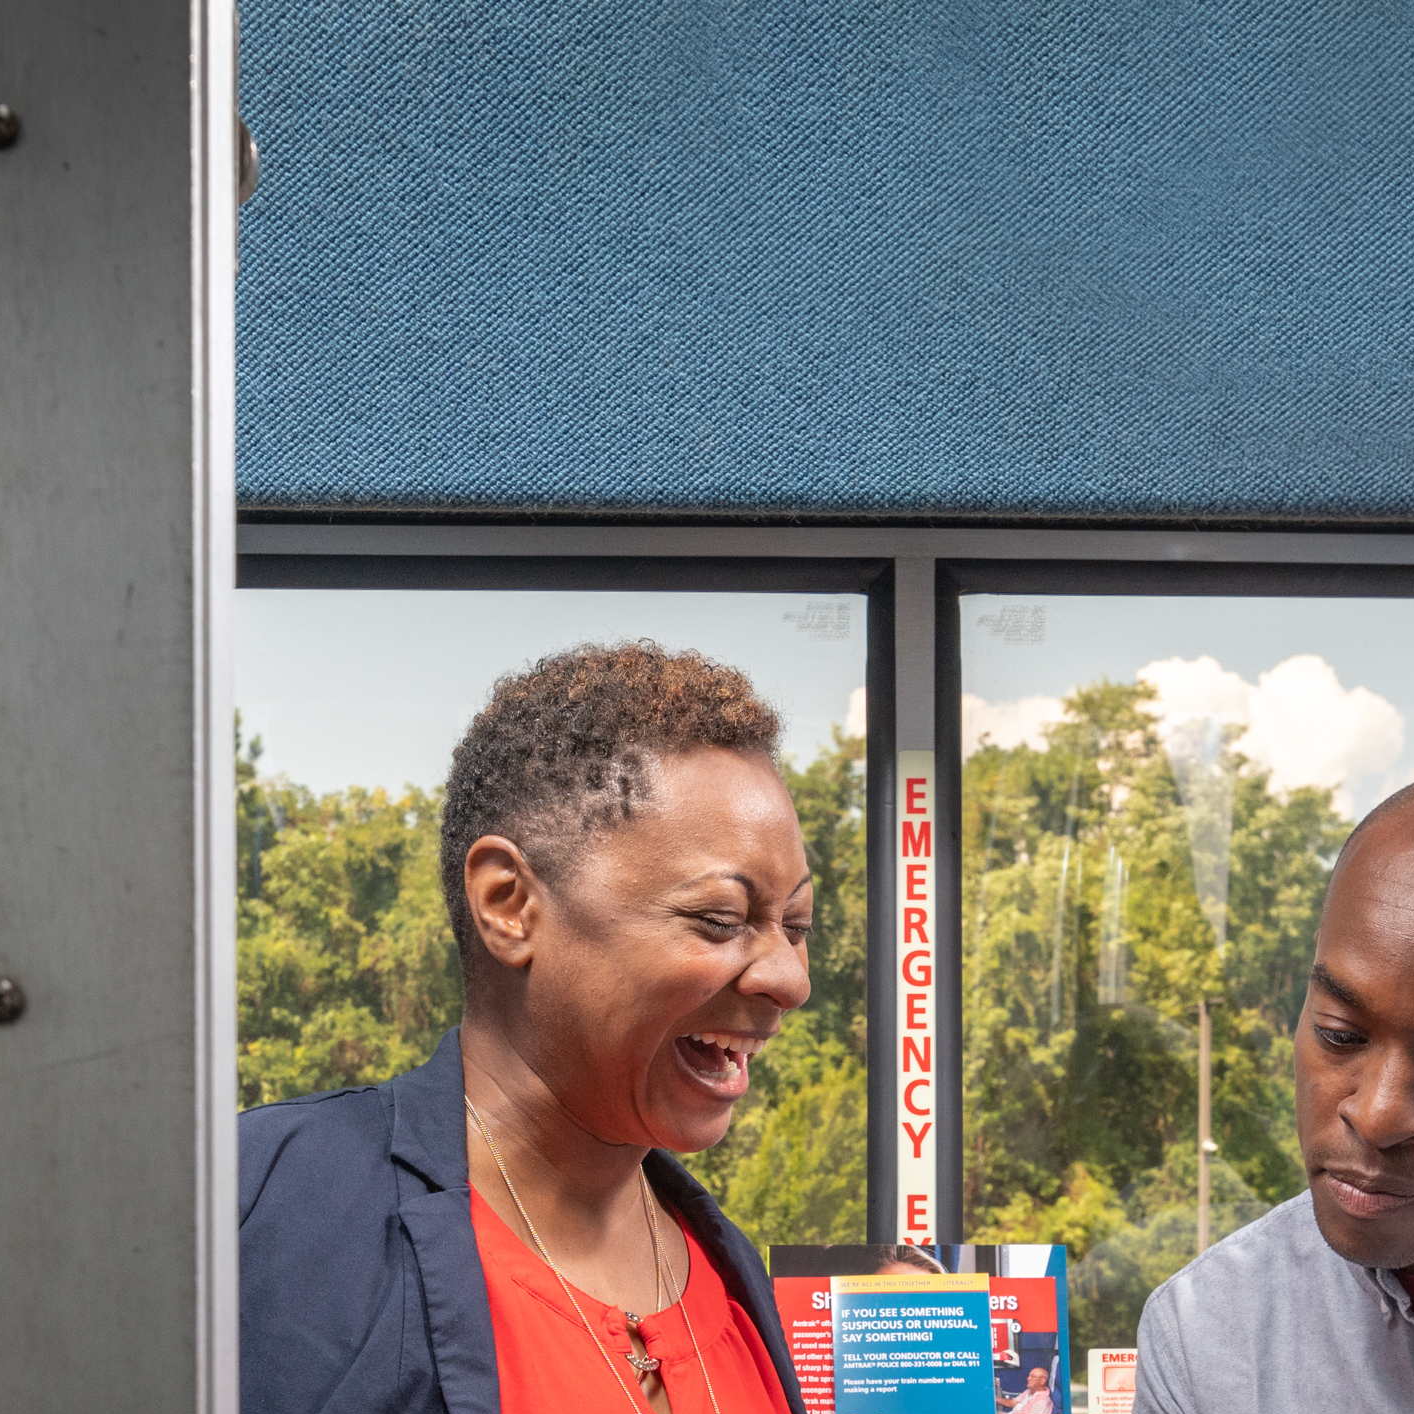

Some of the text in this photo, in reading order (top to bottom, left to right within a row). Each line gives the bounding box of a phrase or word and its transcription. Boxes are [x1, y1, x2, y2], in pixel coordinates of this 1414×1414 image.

[901, 777, 933, 1245] EMERGENCY E
[841, 1306, 964, 1318] IF YOU SEE SOMETHING
[842, 1318, 978, 1331] SUSPICIOUS OR UNUSUAL,
[793, 1331, 832, 1339] passenger's
[842, 1332, 933, 1343] SAY SOMETHING!
[863, 1353, 888, 1361] YOUR
[889, 1352, 942, 1360] CONDUCTOR
[957, 1351, 980, 1359] CALL:
[802, 1364, 821, 1372] sharp
[808, 1375, 819, 1383] the
[843, 1378, 865, 1386] Please
[843, 1386, 869, 1394] making
[876, 1386, 898, 1394] report
[1096, 1396, 1100, 1405] 1
